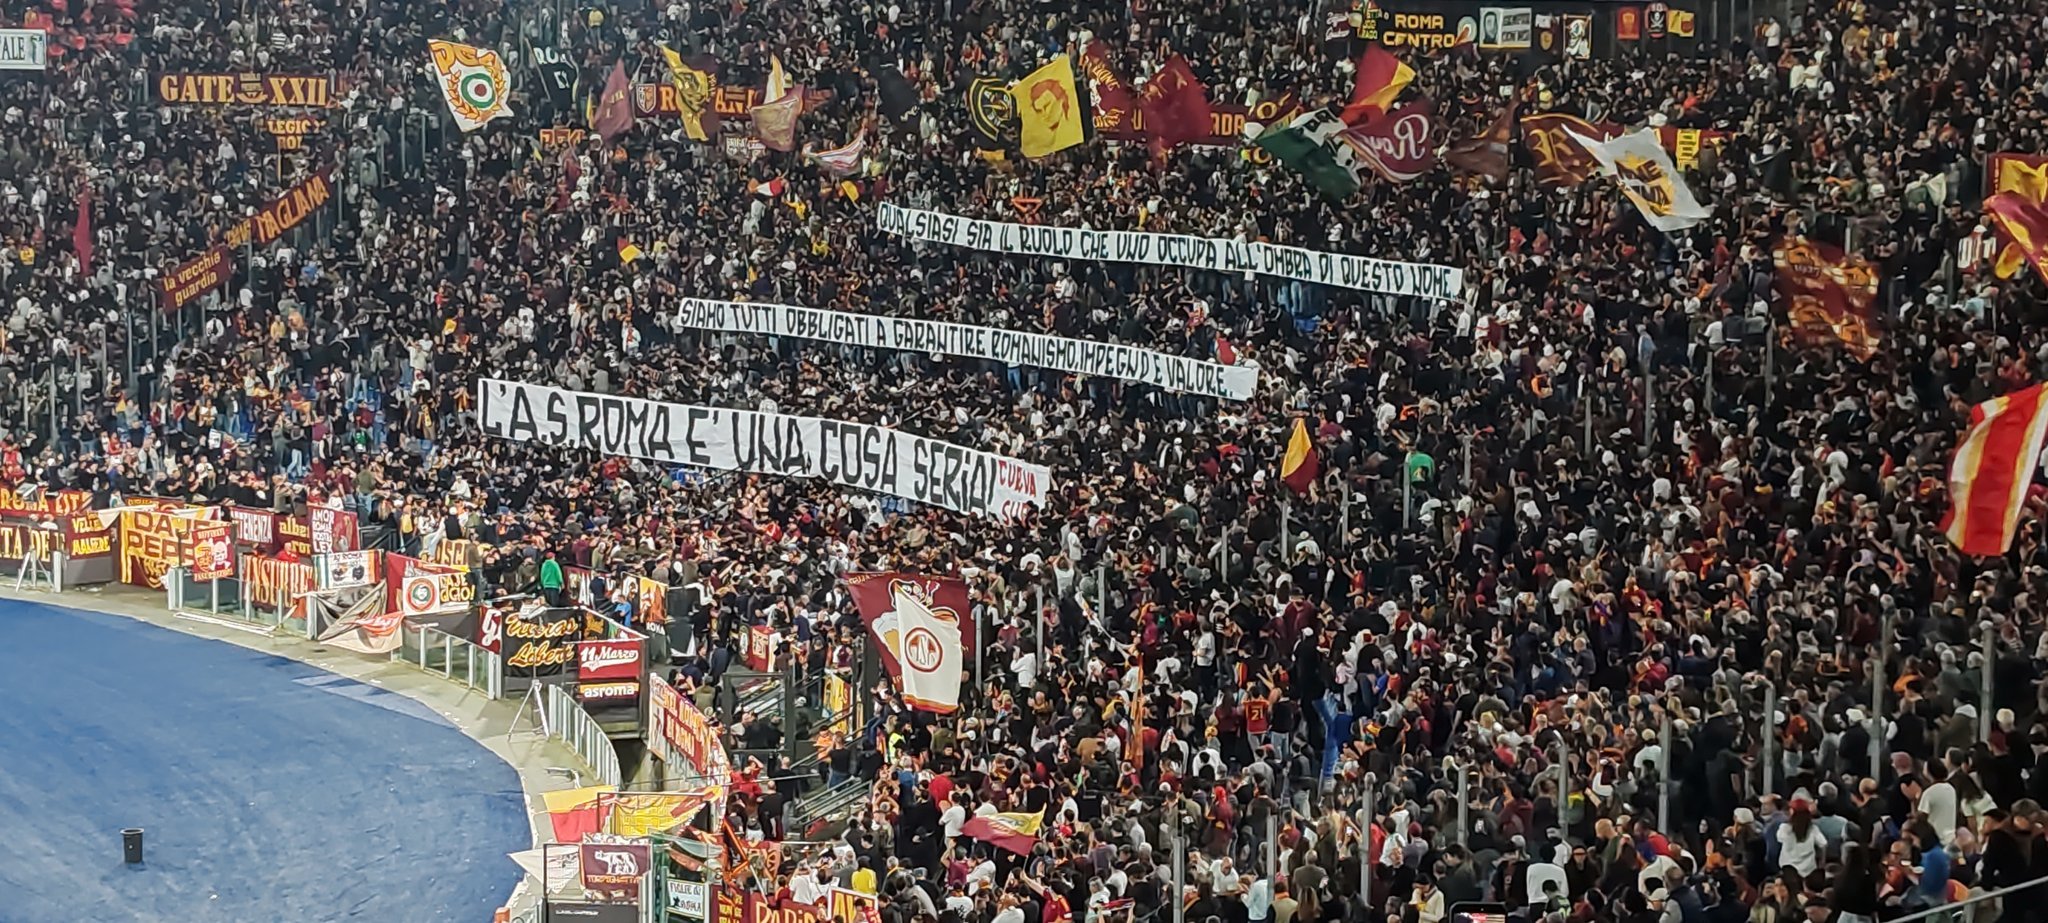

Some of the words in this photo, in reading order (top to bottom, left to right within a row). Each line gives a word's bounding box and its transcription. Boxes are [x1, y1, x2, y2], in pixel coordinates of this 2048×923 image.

[1394, 13, 1445, 30] ROMA
[0, 36, 25, 60] ALE
[1382, 31, 1457, 48] CENTRO
[160, 75, 235, 103] GATE
[268, 77, 327, 106] XXII
[880, 203, 958, 243] QUALSIASI
[967, 222, 992, 248] SIA
[1001, 226, 1014, 252] IL
[1020, 226, 1073, 258] RUOLO
[1080, 231, 1109, 260] CHE
[1116, 234, 1149, 261] UNO
[1157, 236, 1217, 269] OCCUPA
[1225, 240, 1312, 281] ALL'OMBRA
[1319, 252, 1334, 284] DI
[1341, 257, 1403, 293] QUESTO
[163, 275, 176, 292] la
[178, 250, 221, 285] vecchia
[174, 270, 218, 307] guardia
[681, 299, 725, 328] SIAMO
[730, 303, 777, 333] TUTTI
[786, 308, 869, 345] OBBLIGATI
[876, 319, 887, 348] A
[893, 320, 986, 356] GARANTIRE
[1153, 354, 1163, 384] E
[686, 408, 720, 465] E'
[820, 420, 898, 495] COSA
[0, 527, 24, 559] TA
[580, 646, 597, 662] 11
[584, 686, 635, 698] asroma
